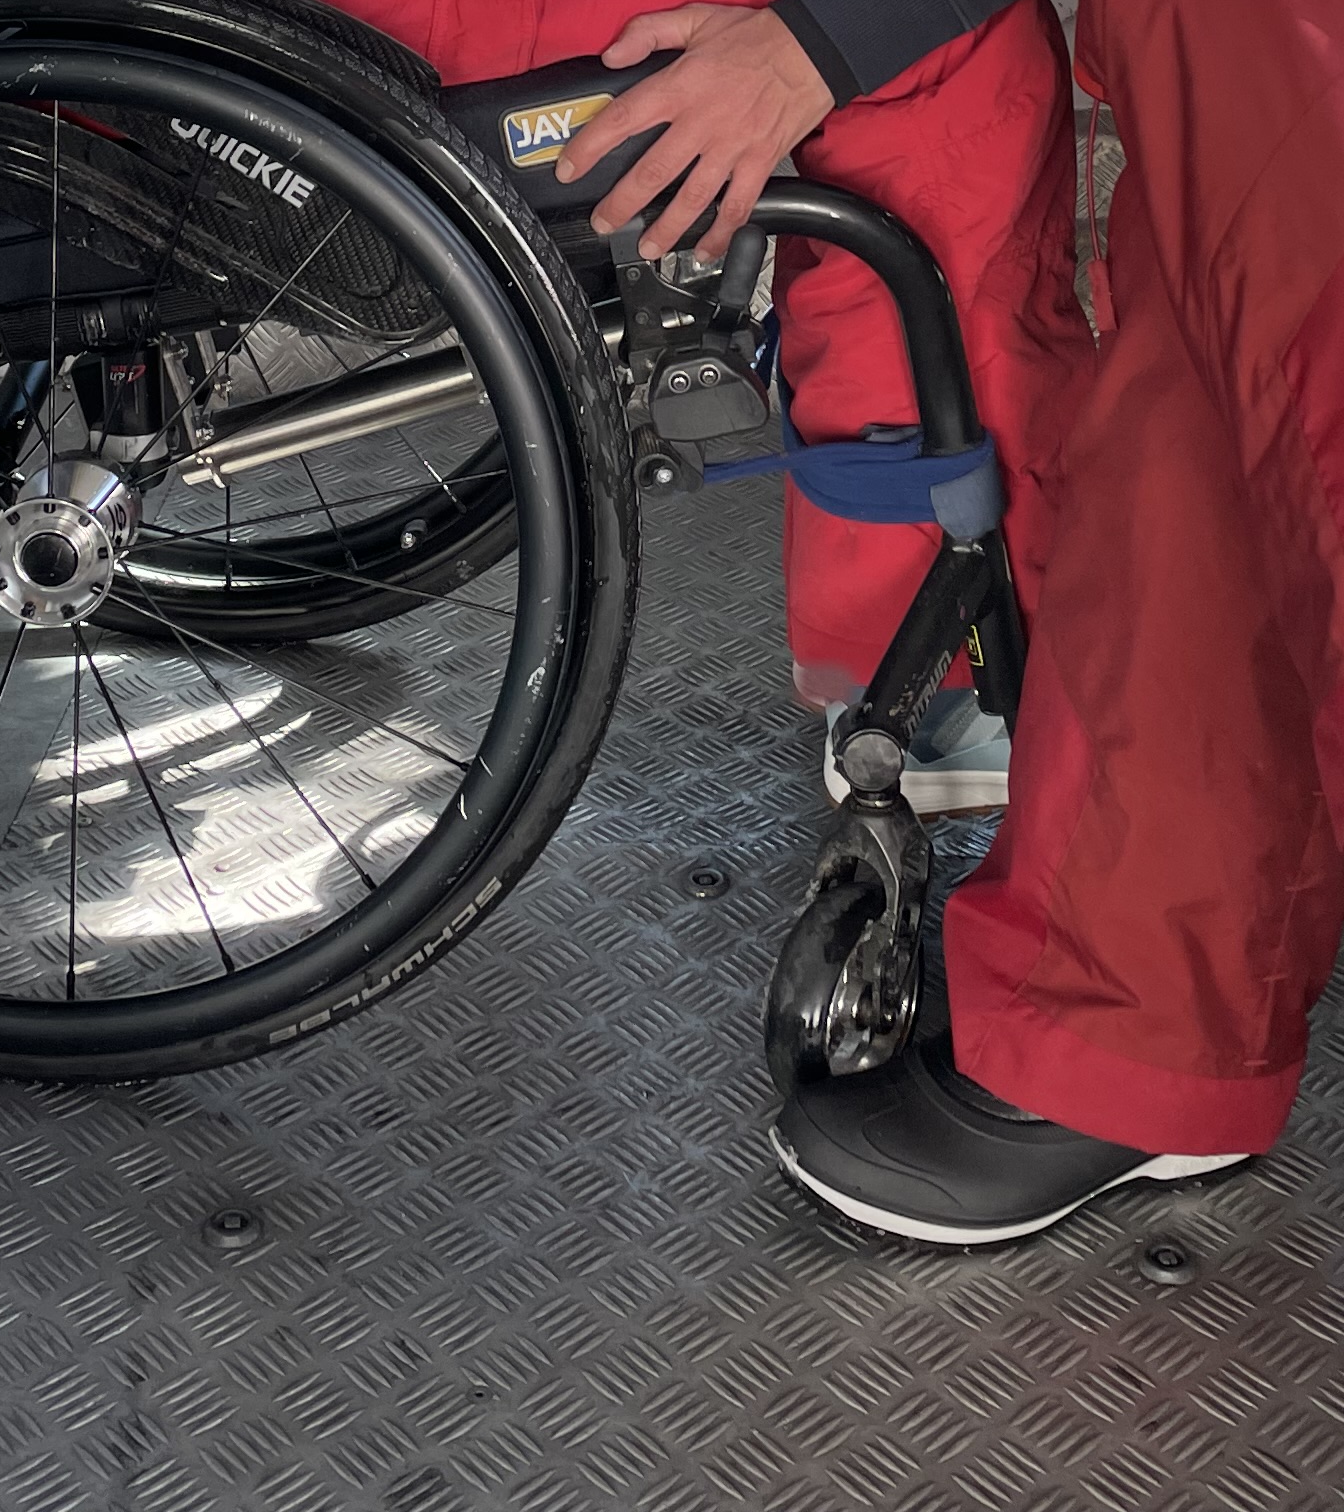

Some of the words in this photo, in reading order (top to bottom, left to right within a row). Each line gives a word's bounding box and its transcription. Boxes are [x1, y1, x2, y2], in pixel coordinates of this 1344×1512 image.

[169, 117, 316, 209] QUICKIE
[516, 107, 574, 149] JAY
[268, 875, 503, 1045] SCHWALBE
